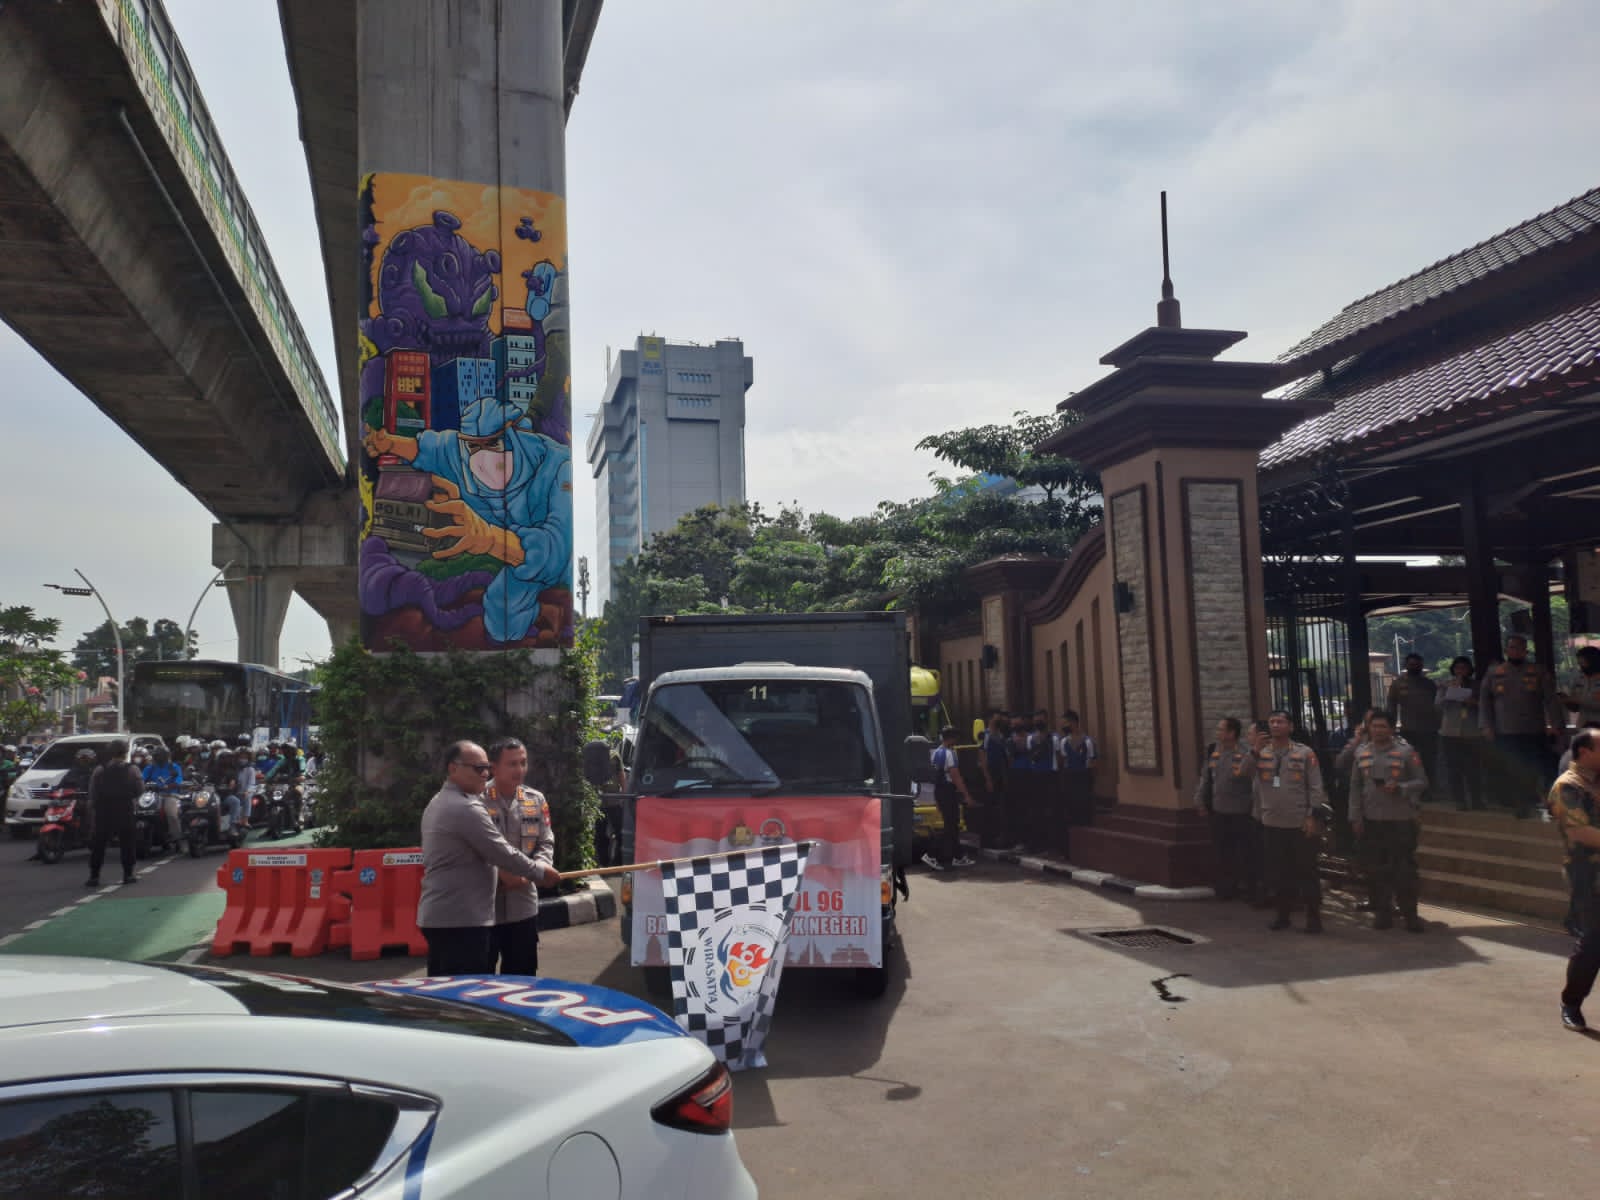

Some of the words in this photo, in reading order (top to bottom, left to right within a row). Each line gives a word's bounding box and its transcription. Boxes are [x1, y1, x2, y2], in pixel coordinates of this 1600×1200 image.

[748, 685, 768, 700] 11
[817, 890, 844, 912] 96
[808, 915, 867, 936] NEGERI
[703, 937, 718, 1004] WIRASATYA
